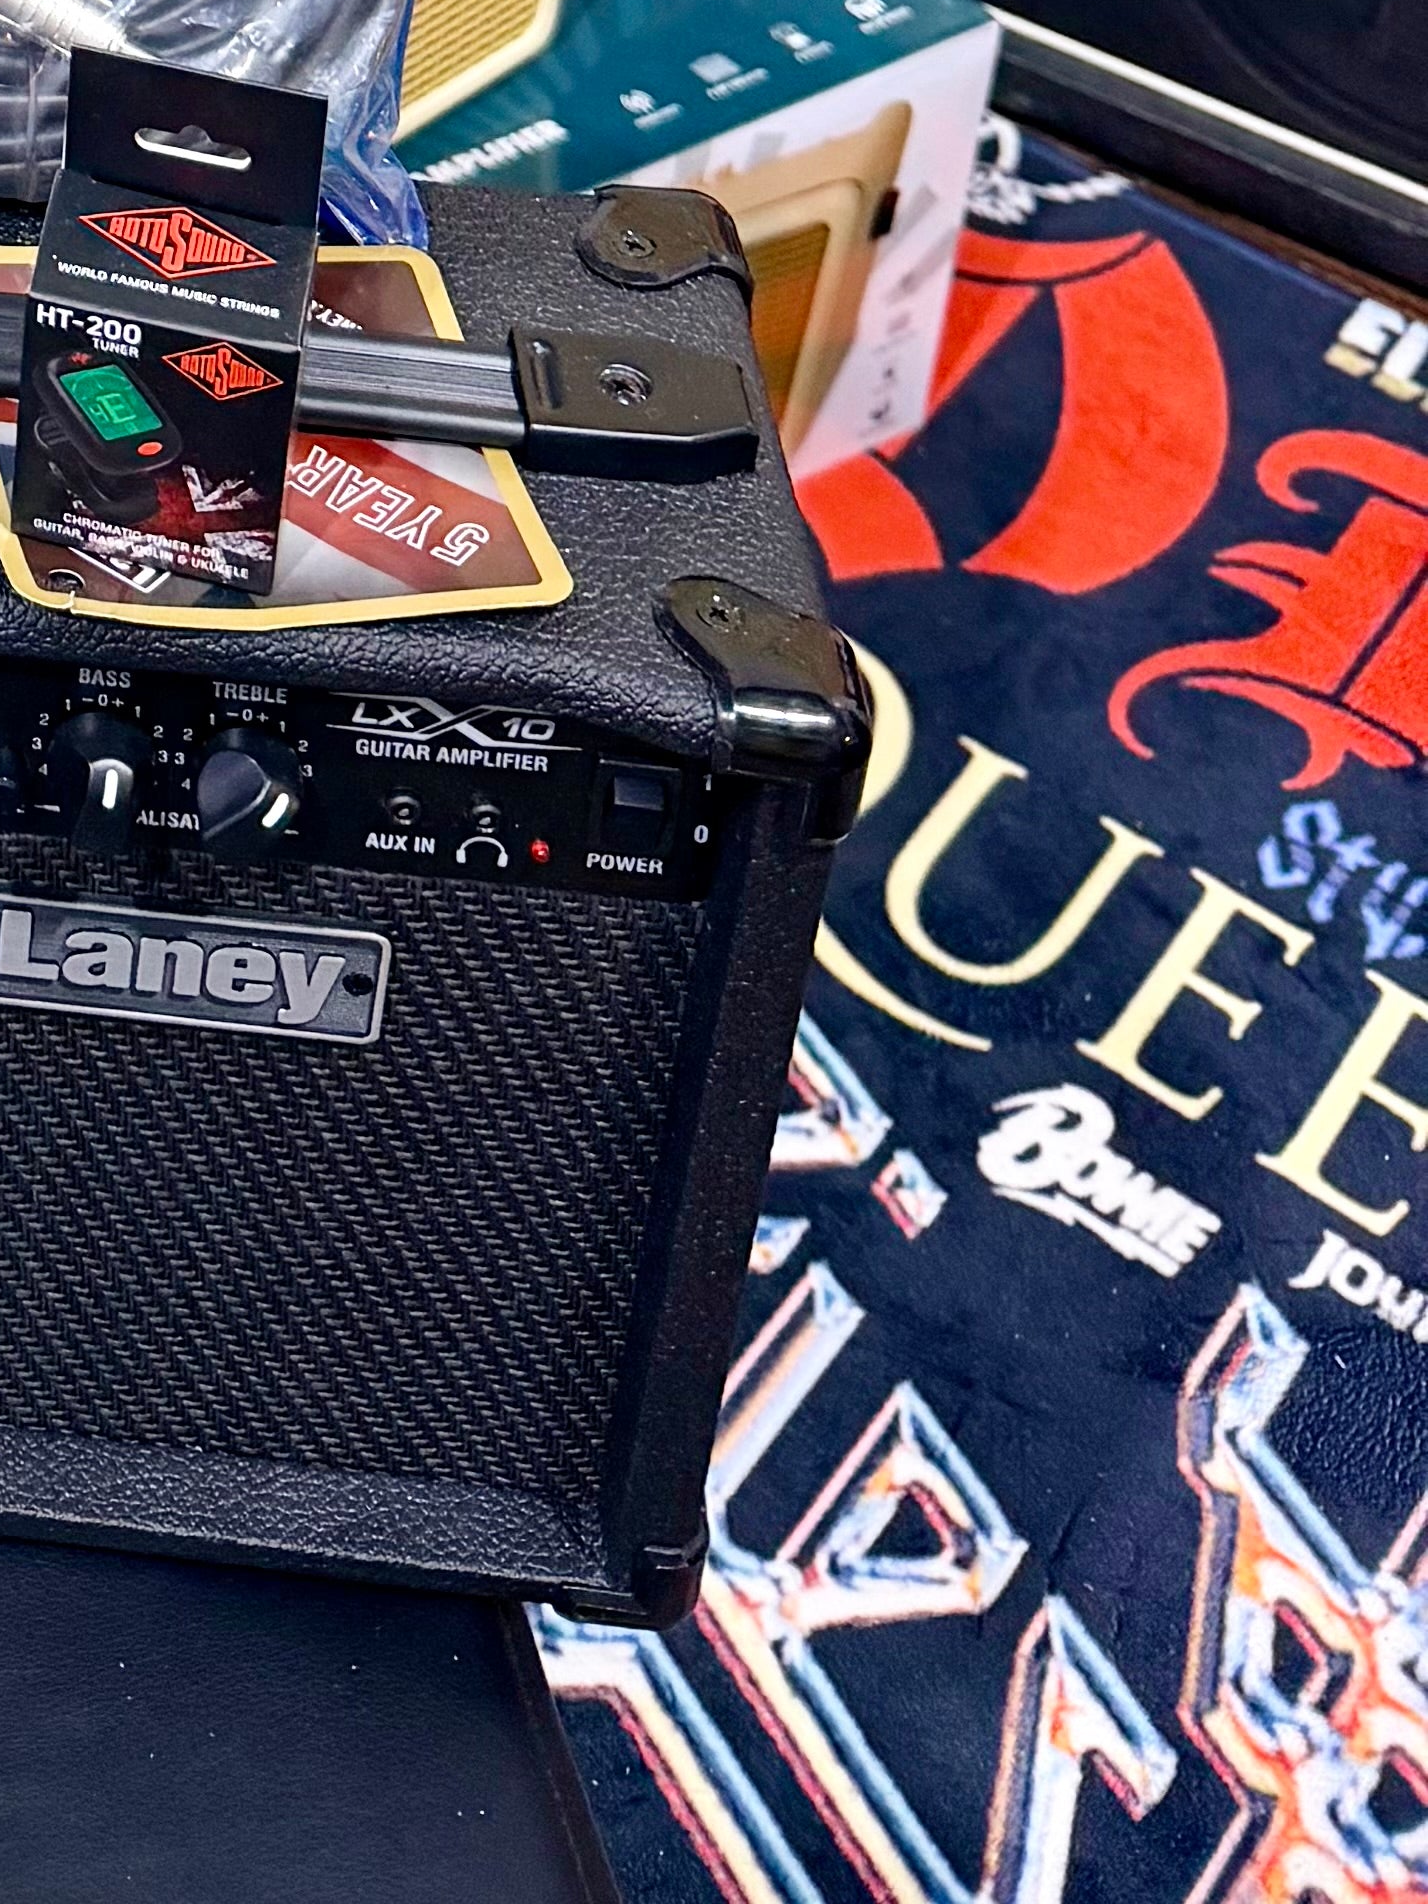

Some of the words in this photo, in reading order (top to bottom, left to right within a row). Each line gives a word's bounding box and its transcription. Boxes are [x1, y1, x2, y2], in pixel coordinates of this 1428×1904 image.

[109, 213, 245, 273] ROTOSOUND
[58, 262, 108, 282] WORLD
[110, 272, 169, 295] FAMOUS
[172, 285, 218, 306] MUSIC
[220, 297, 281, 319] STRINGS
[36, 303, 143, 346] HT-200
[92, 337, 140, 359] TUNER
[287, 445, 443, 550] YEAR
[63, 512, 143, 540] CHROMATIC
[147, 534, 190, 554] TUNER
[431, 521, 490, 568] 5
[79, 667, 132, 689] BASS
[212, 681, 288, 706] TREBLE
[354, 739, 431, 762] GUITAR
[434, 745, 549, 773] AMPLIFIER
[364, 830, 407, 853] AUX
[411, 833, 437, 855] IN
[585, 851, 665, 876] POWER
